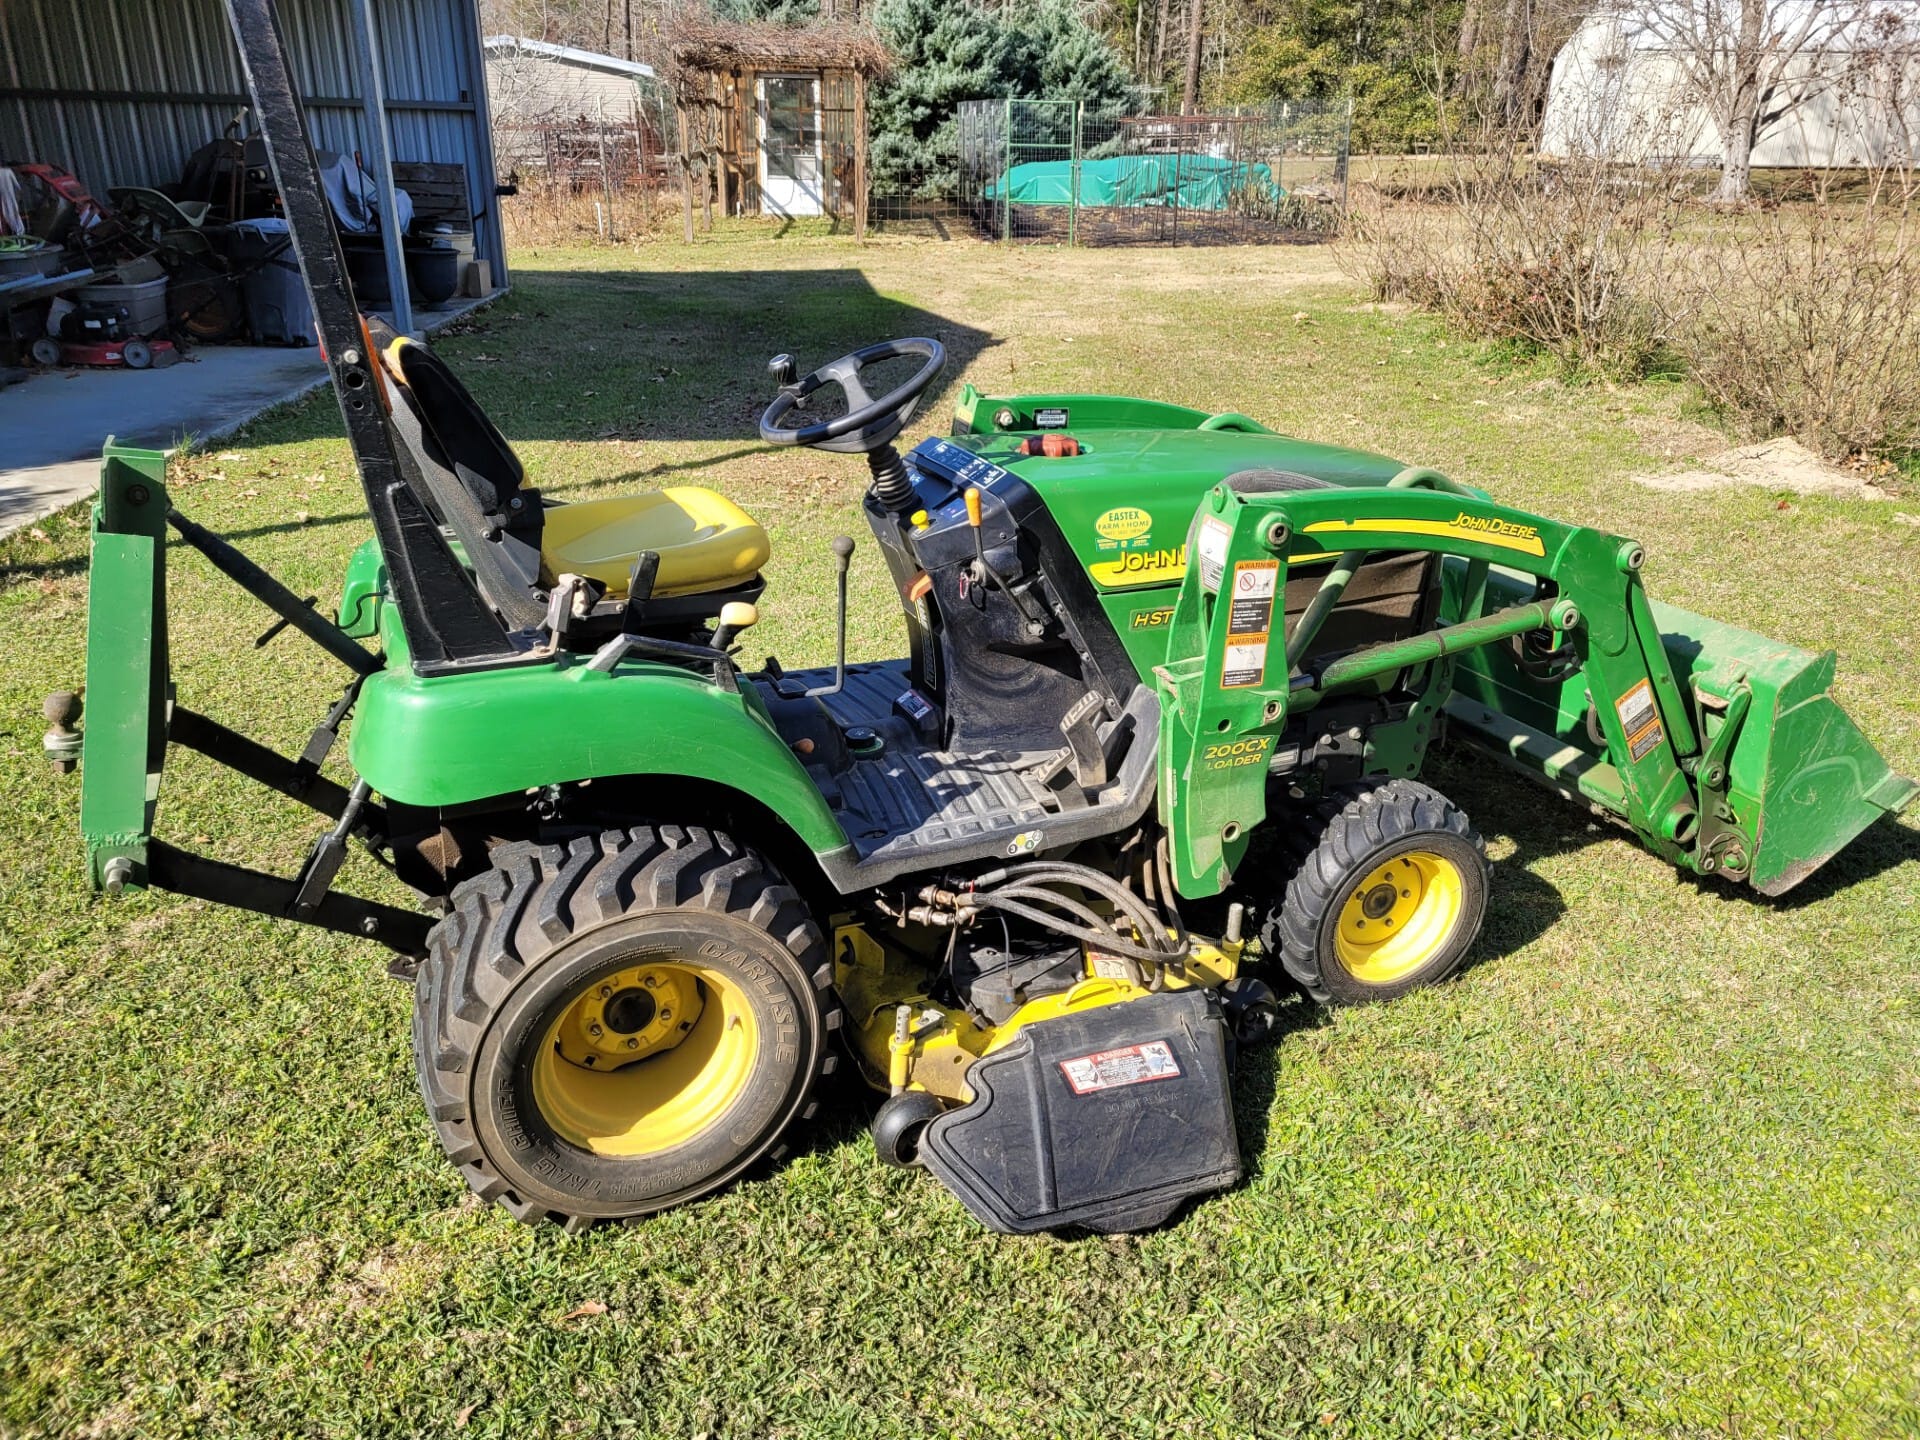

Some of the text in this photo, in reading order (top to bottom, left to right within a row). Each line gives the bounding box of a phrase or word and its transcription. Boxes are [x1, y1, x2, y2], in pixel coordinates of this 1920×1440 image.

[1108, 511, 1139, 521] EASTEX
[1449, 512, 1538, 539] JOHN DEERE
[1112, 548, 1179, 574] JOHN
[1245, 560, 1277, 569] WARNING
[1133, 609, 1174, 628] HST
[1204, 737, 1271, 760] 200CX
[1207, 753, 1262, 770] LOADER
[698, 939, 797, 1064] CARLISLE
